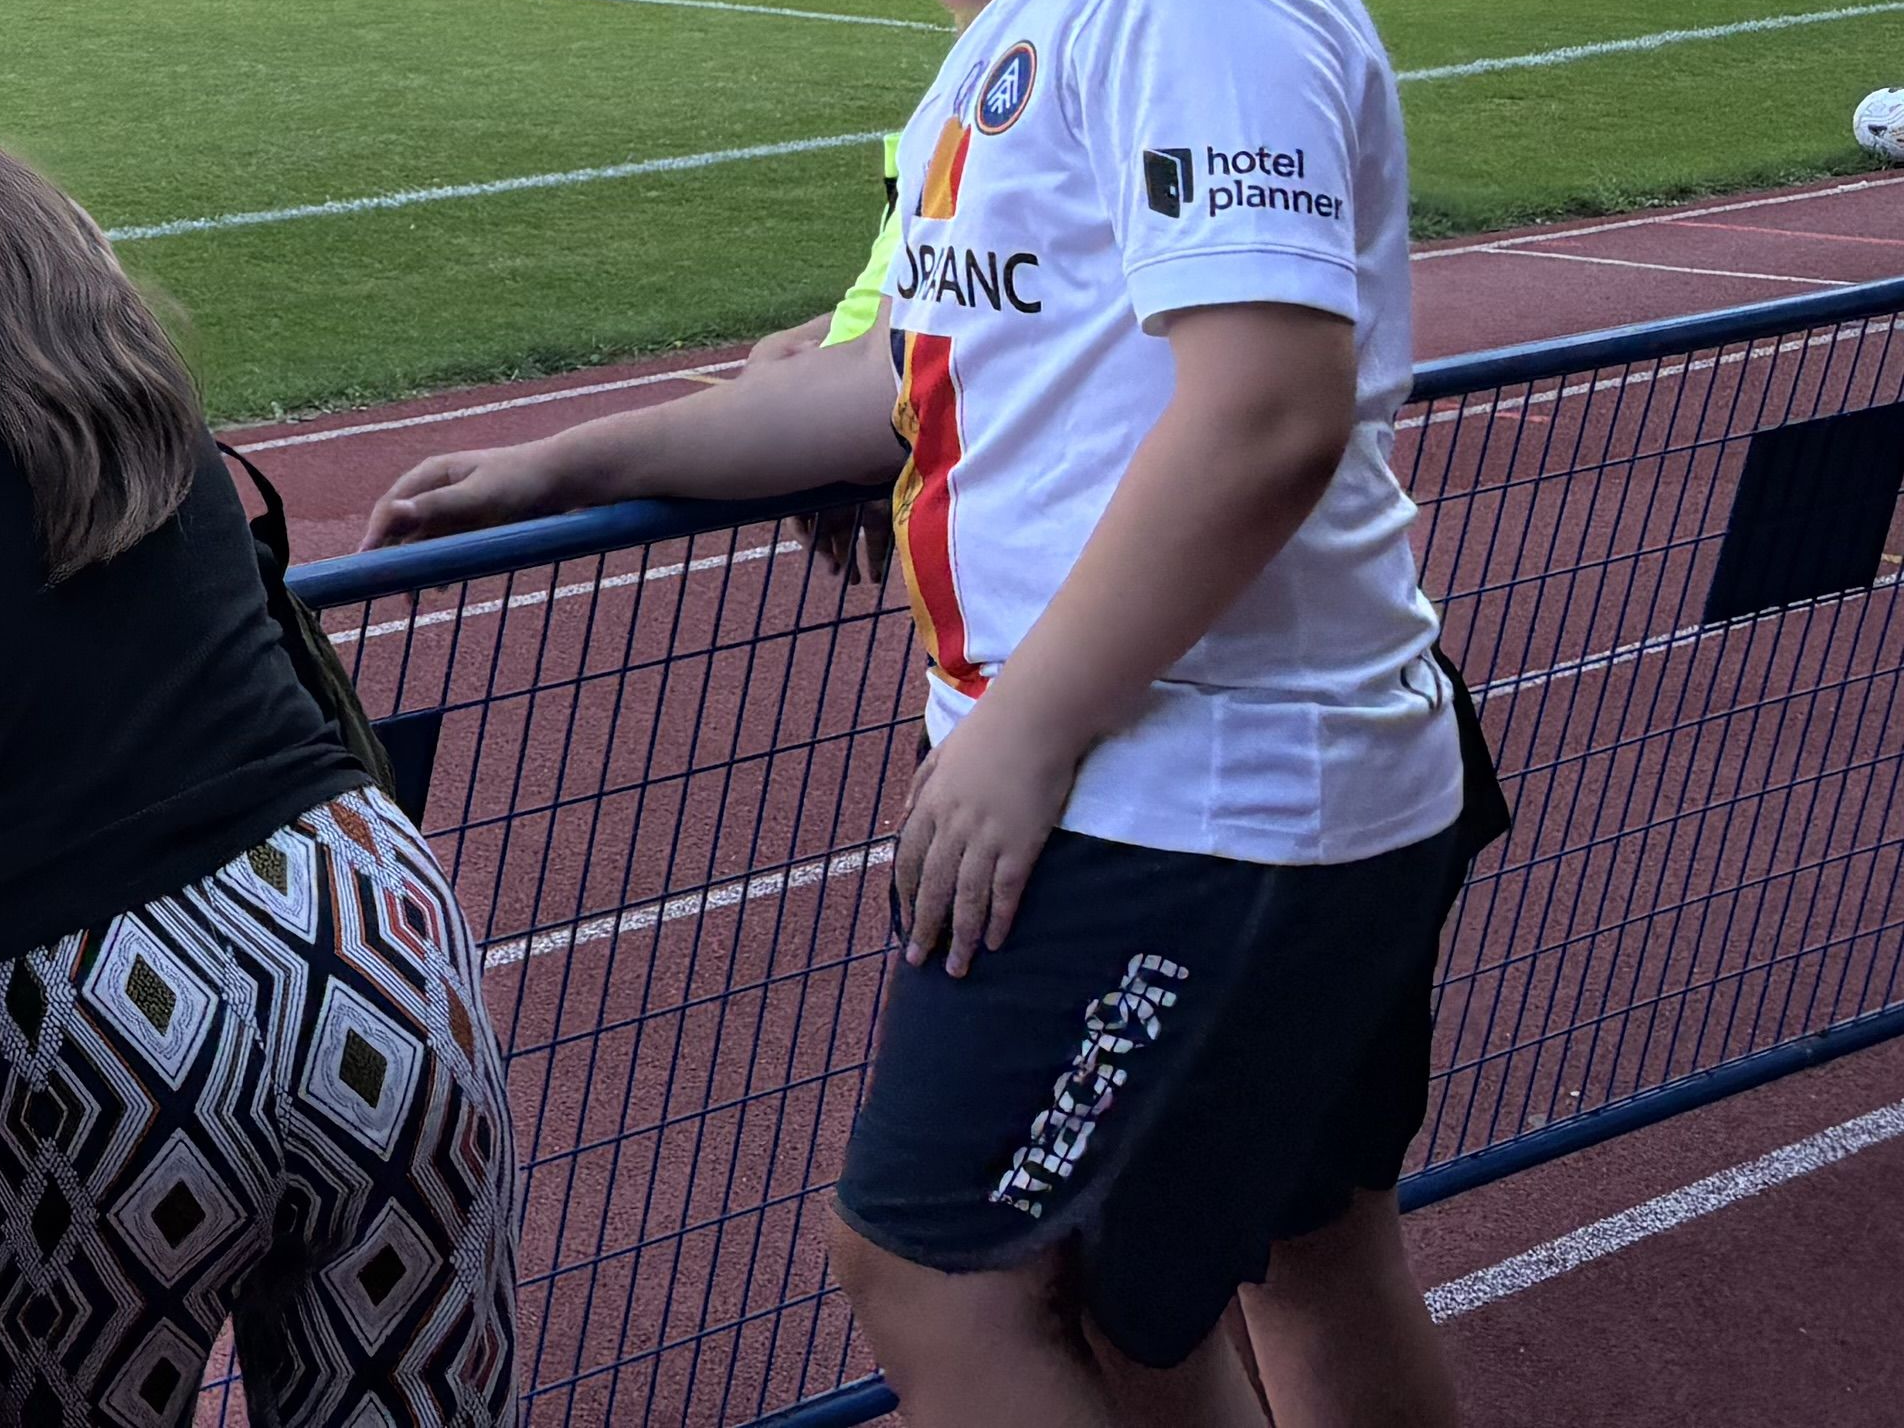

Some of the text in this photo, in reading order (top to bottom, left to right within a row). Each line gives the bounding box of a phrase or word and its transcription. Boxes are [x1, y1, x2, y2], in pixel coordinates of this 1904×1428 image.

[1207, 144, 1304, 179] hotel
[1208, 179, 1344, 220] planner
[987, 952, 1190, 1219] macron
